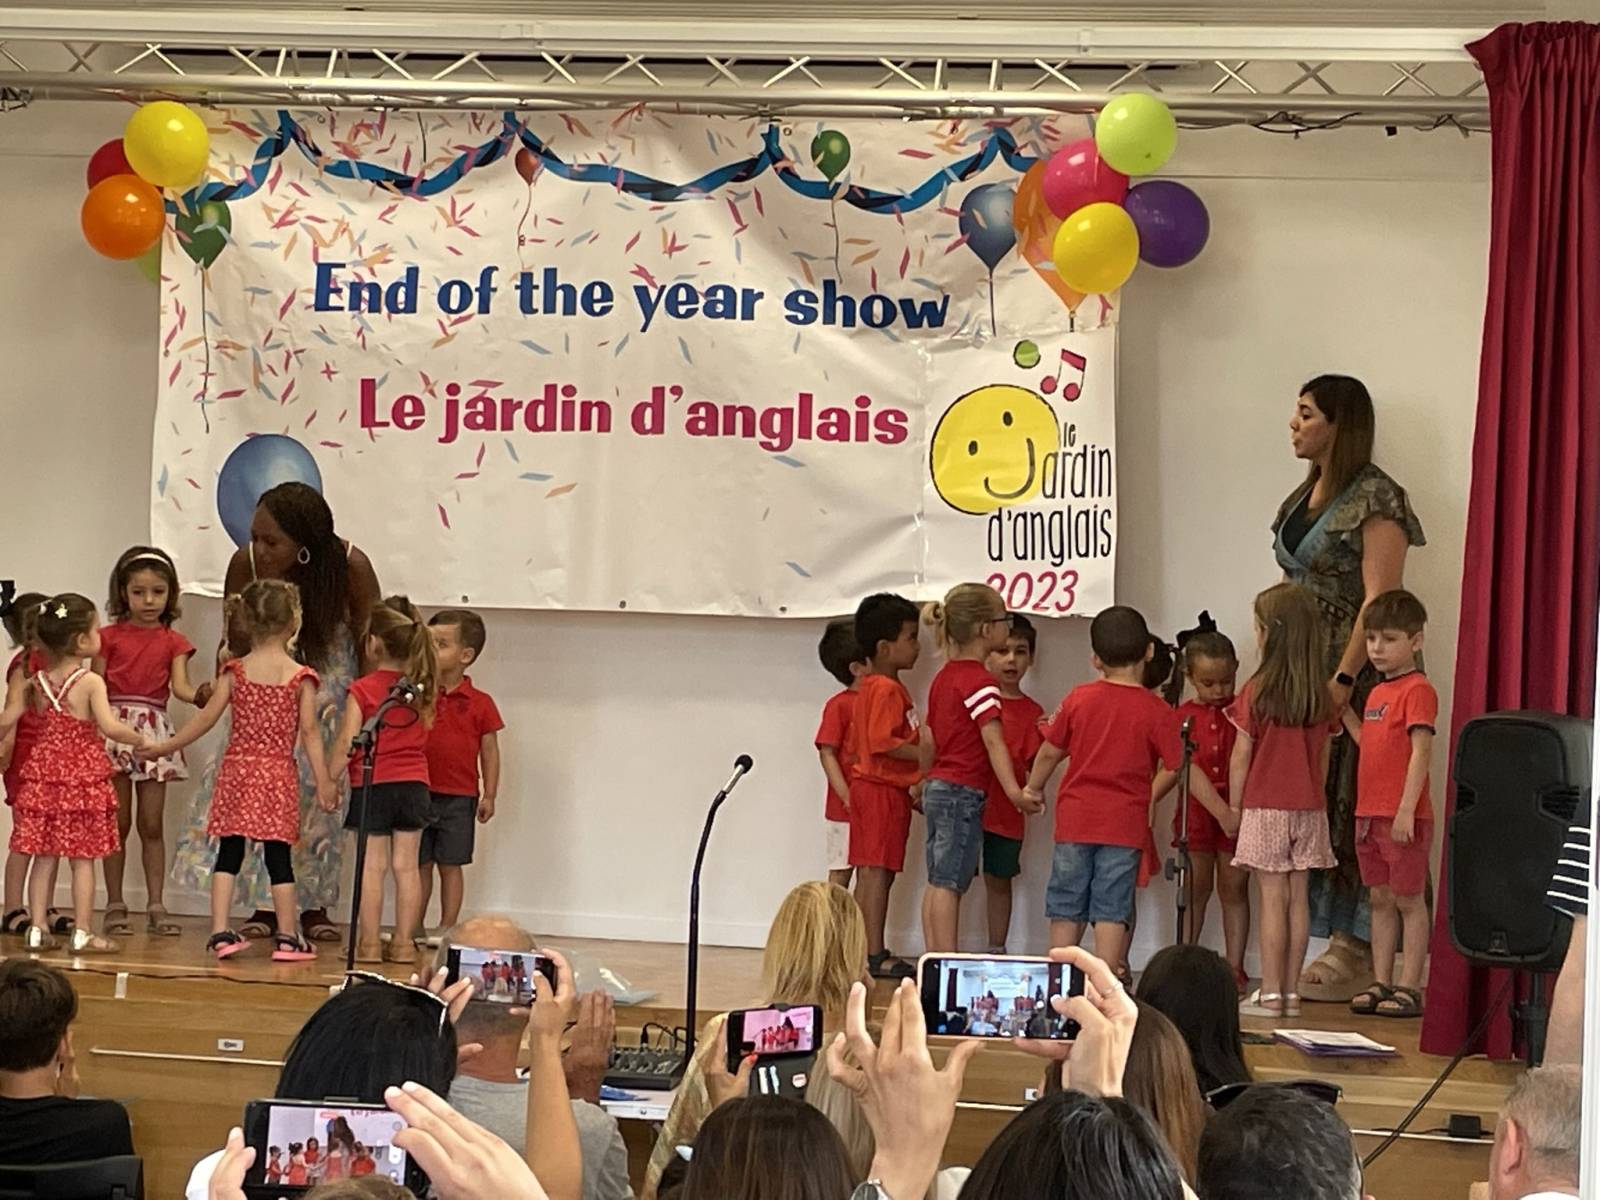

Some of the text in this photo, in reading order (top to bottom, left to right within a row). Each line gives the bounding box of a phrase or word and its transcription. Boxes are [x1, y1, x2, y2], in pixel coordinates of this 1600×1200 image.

[314, 262, 950, 333] End of the year show
[360, 377, 426, 431] Le
[438, 382, 612, 444] jardin
[1063, 421, 1076, 448] le
[987, 504, 1112, 567] d'anglais
